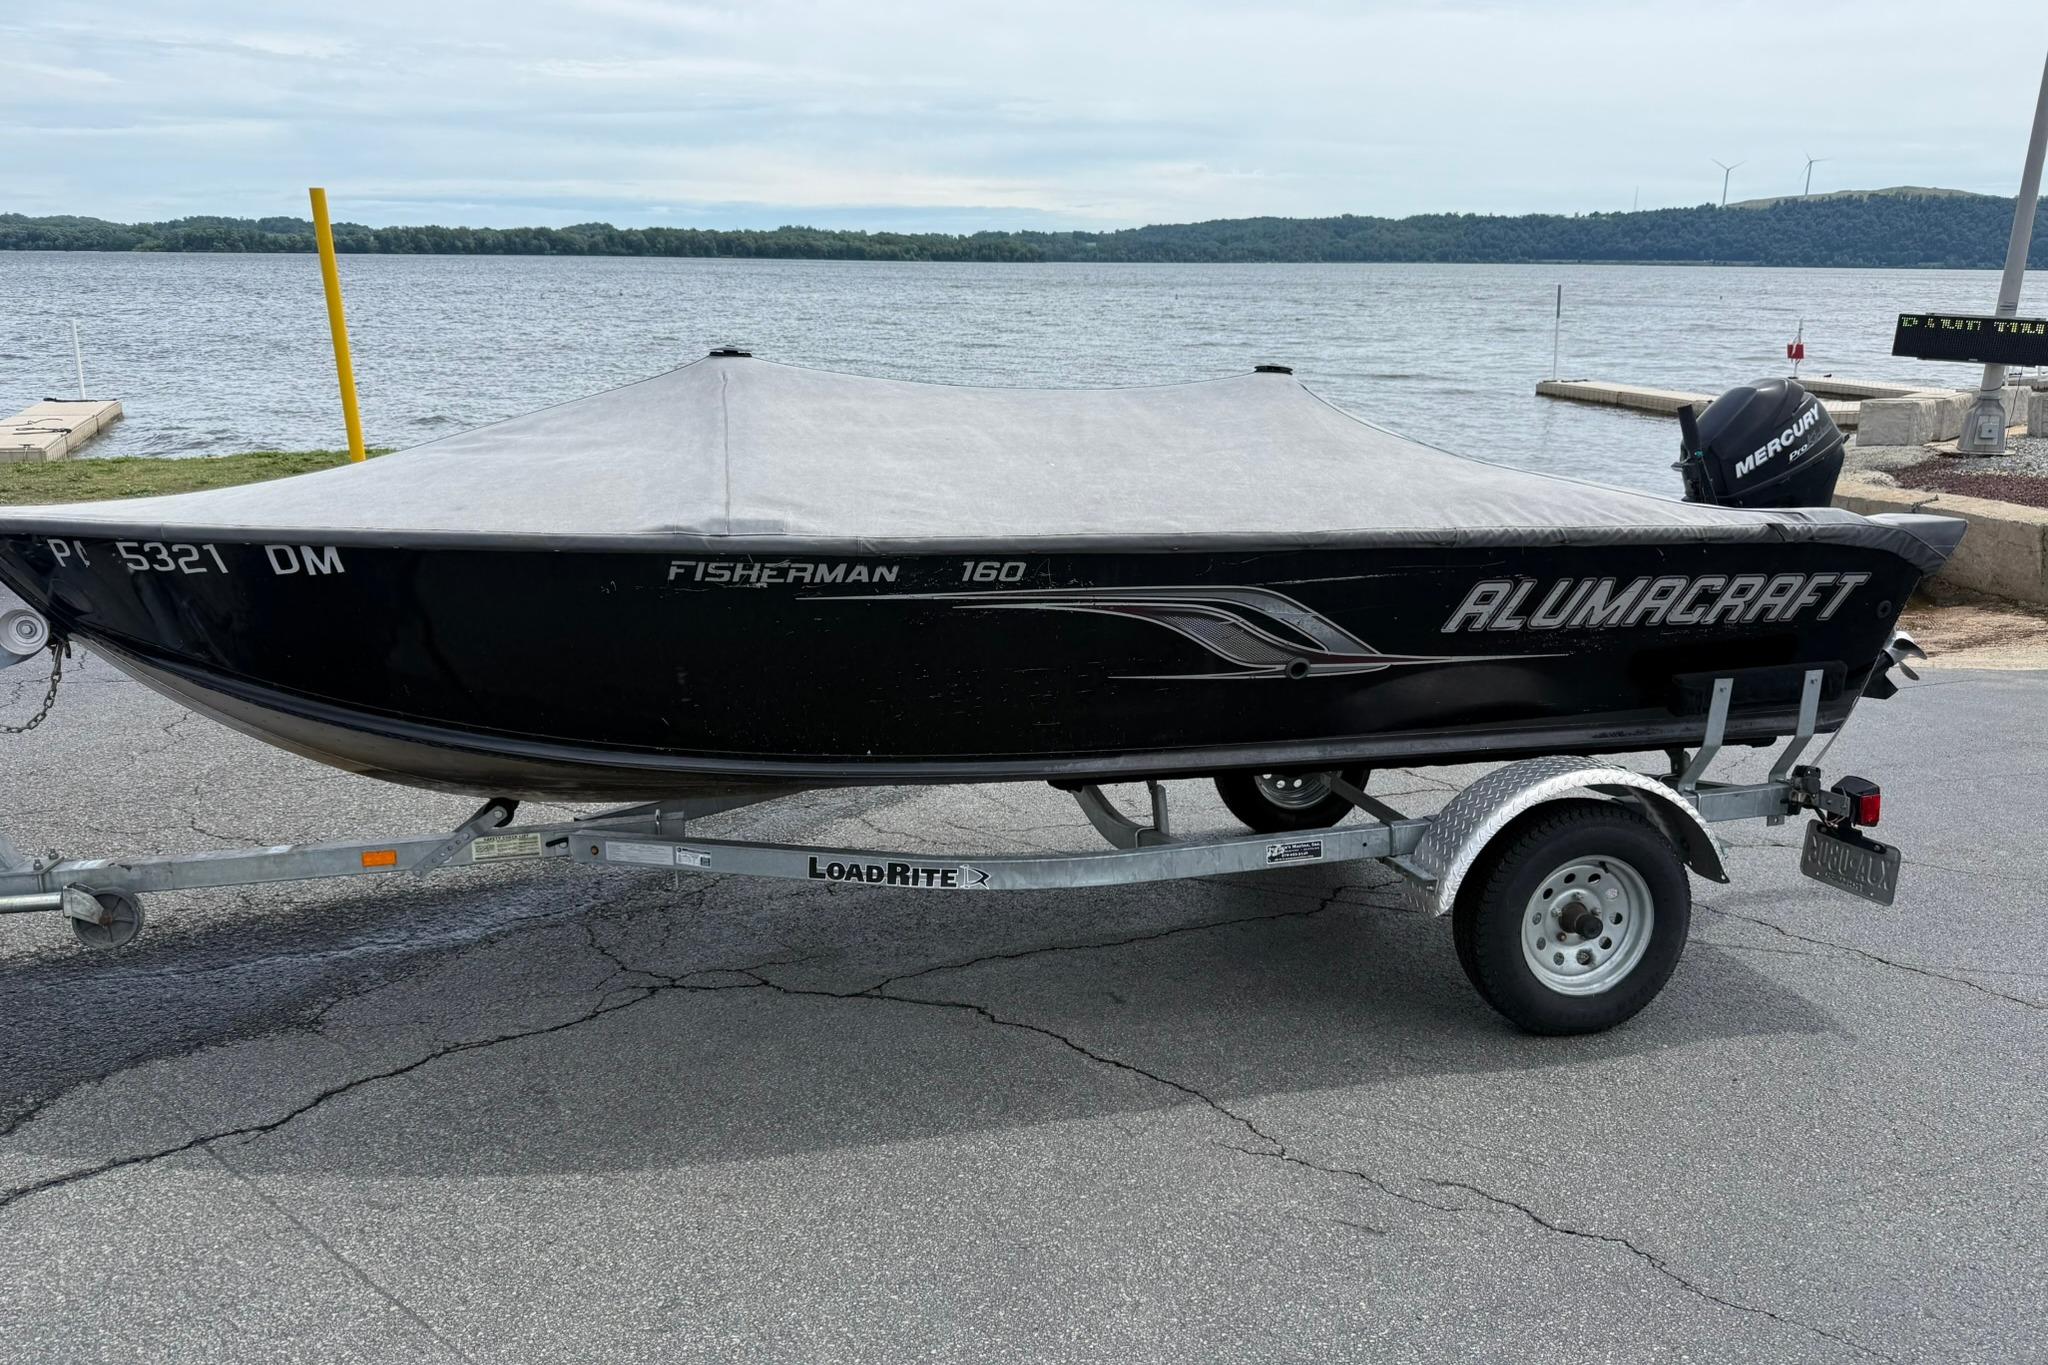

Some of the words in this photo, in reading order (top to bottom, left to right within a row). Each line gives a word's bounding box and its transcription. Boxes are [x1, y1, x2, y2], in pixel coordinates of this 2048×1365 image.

[1735, 403, 1819, 478] MERCURY
[116, 541, 229, 575] 5321
[264, 544, 345, 576] DM
[668, 560, 900, 583] FISHERMAN
[961, 561, 1027, 582] 160
[1441, 572, 1871, 633] ALUMACRAFT
